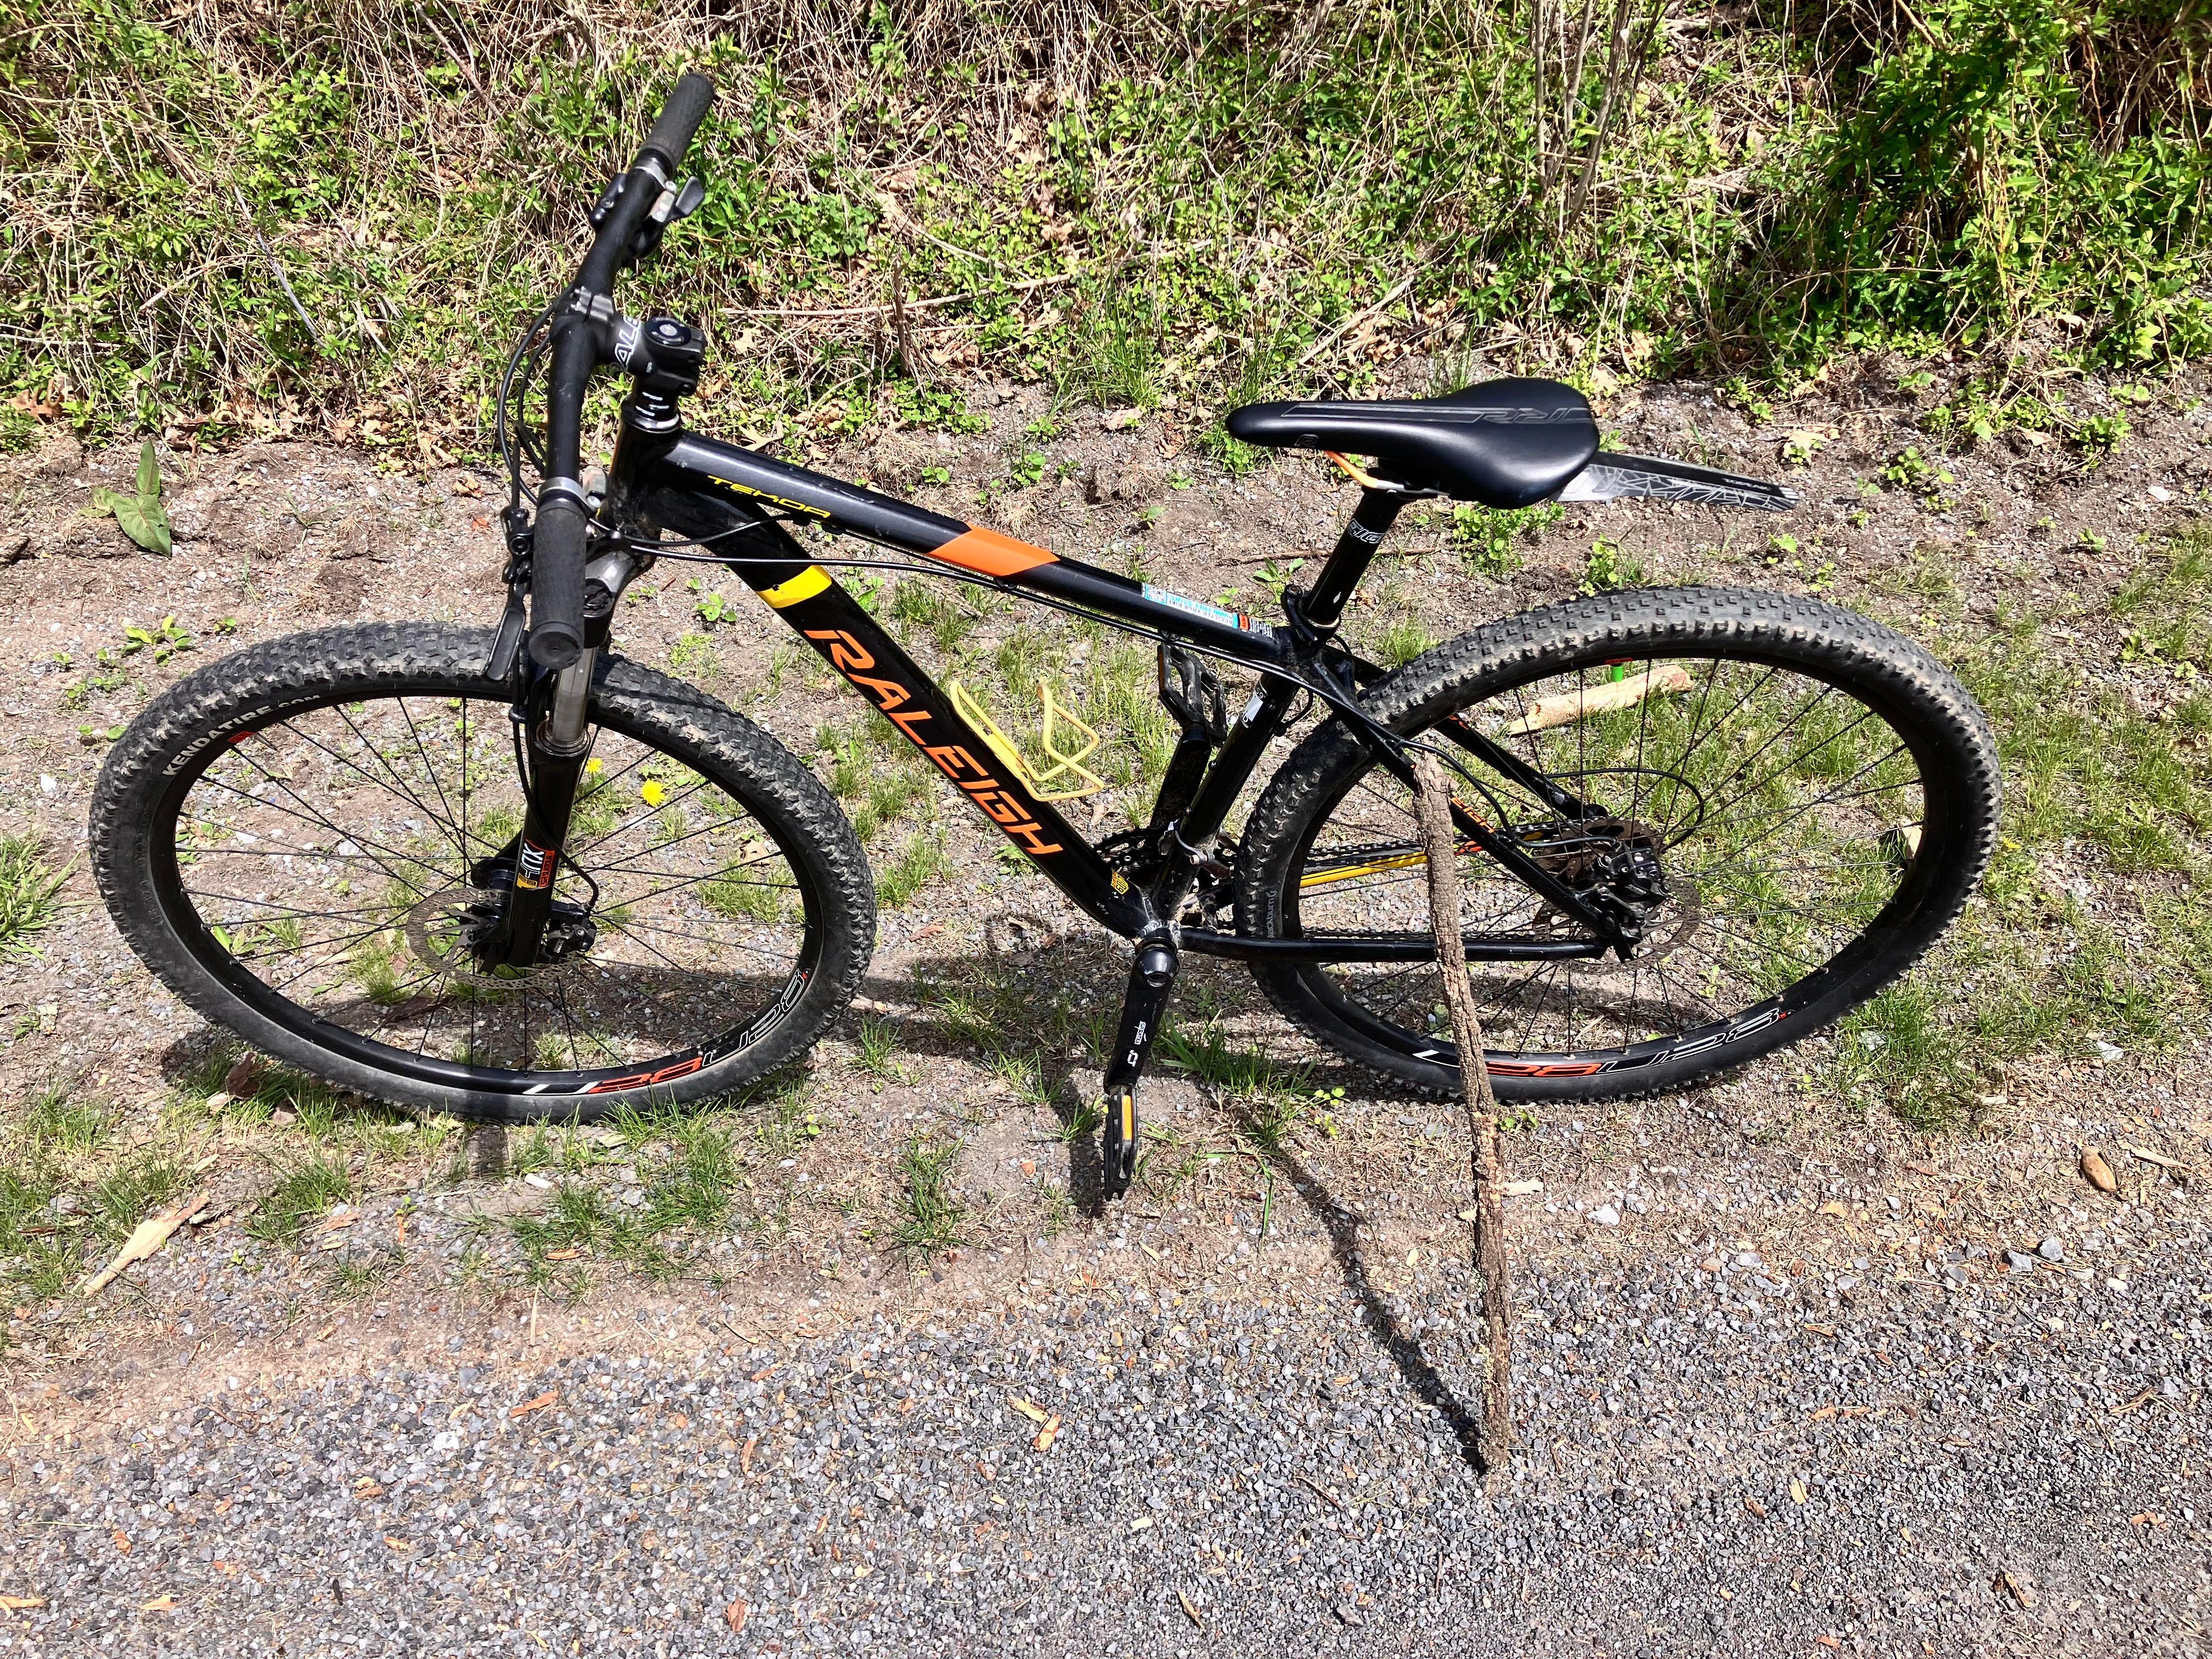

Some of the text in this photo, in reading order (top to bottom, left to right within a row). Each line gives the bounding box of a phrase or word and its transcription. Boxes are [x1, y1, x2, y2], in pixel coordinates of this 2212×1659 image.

[707, 475, 831, 518] TEKOA
[162, 694, 320, 776] KENDATIRE.COM
[803, 629, 1064, 855] RALEIGH
[1450, 797, 1494, 833] EIGH
